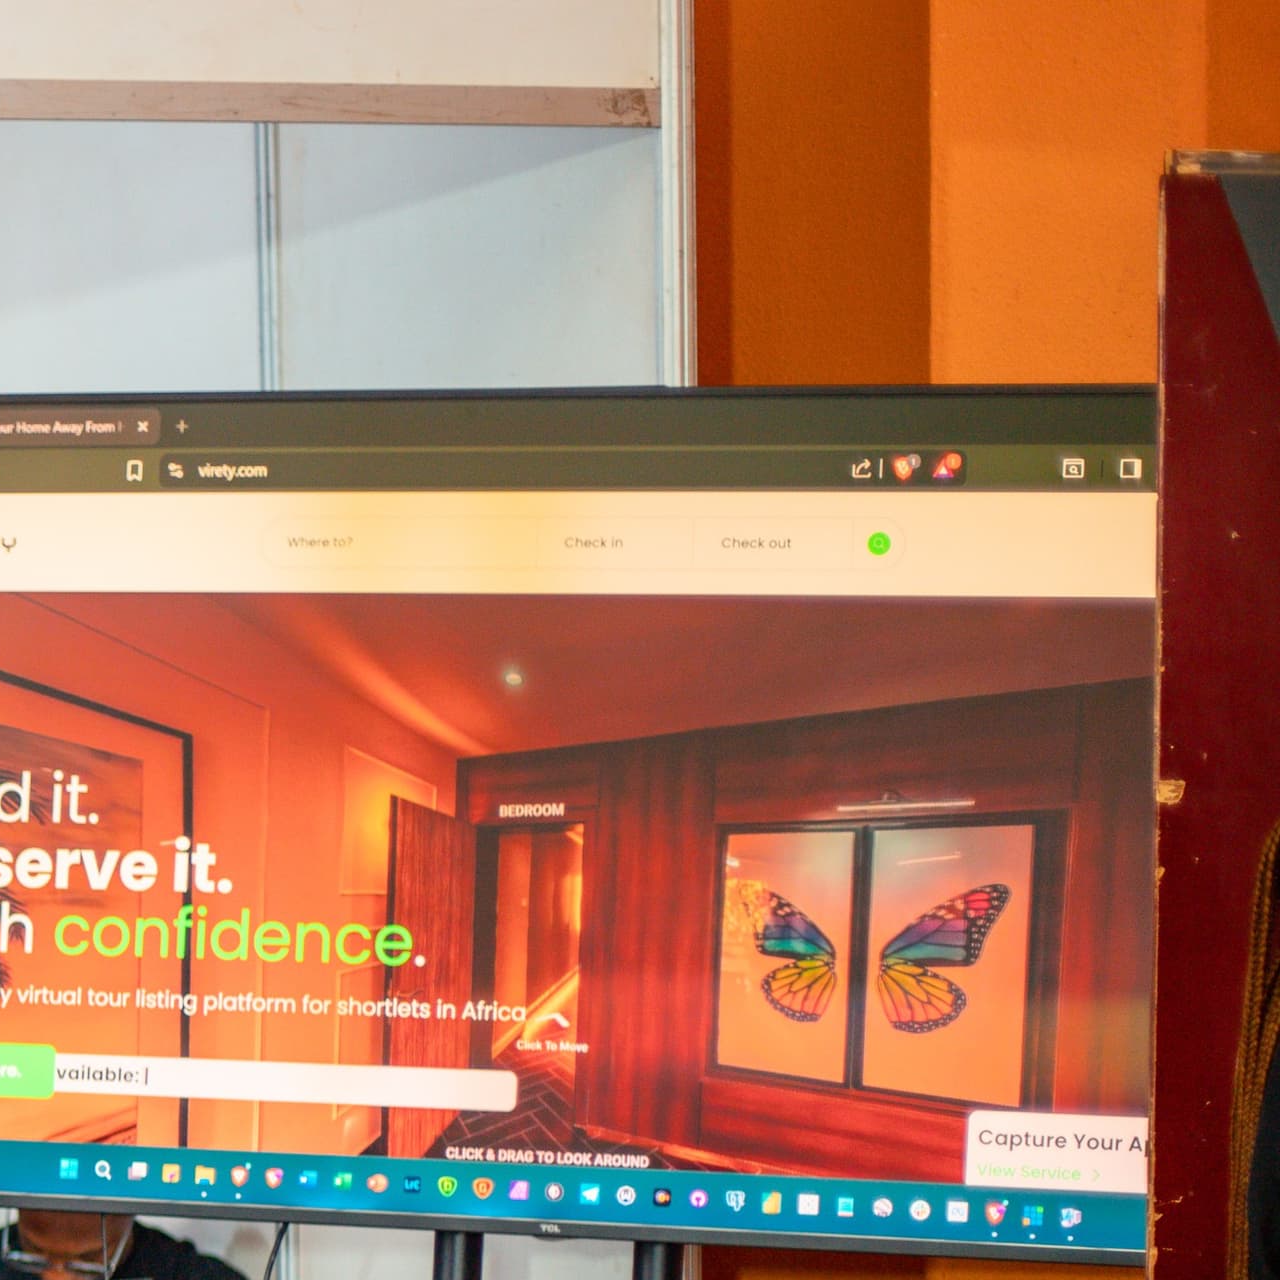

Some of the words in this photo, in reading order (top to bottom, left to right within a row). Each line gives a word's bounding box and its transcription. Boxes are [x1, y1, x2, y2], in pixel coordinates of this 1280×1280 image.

[16, 421, 50, 435] Home
[52, 420, 83, 436] Away
[85, 420, 115, 434] From
[197, 461, 268, 482] virety.com
[287, 536, 330, 548] Where
[333, 536, 354, 548] to?
[564, 536, 606, 549] Check
[611, 536, 623, 549] in
[721, 537, 764, 549] Check
[768, 538, 791, 549] out
[50, 770, 100, 826] it.
[499, 802, 565, 818] BEDROOM
[173, 836, 234, 895] it.
[53, 904, 427, 968] confidence.
[17, 984, 82, 1006] virtual
[87, 987, 131, 1007] tour
[135, 988, 198, 1016] listing
[203, 991, 297, 1016] platform
[302, 993, 332, 1014] for
[336, 996, 431, 1020] shortlets
[436, 998, 456, 1020] in
[461, 999, 526, 1023] Africa
[516, 1040, 542, 1051] Click
[545, 1041, 557, 1052] To
[559, 1041, 589, 1053] Move
[978, 1129, 1068, 1152] Capture
[1073, 1133, 1124, 1151] Your
[445, 1146, 484, 1161] CLICK
[486, 1148, 496, 1161] &
[498, 1149, 533, 1163] DRAG
[536, 1150, 555, 1164] TO
[557, 1151, 592, 1166] LOOK
[594, 1153, 650, 1169] AROUND
[977, 1163, 1016, 1178] View
[1020, 1164, 1082, 1181] Service
[540, 1223, 561, 1234] TCL
